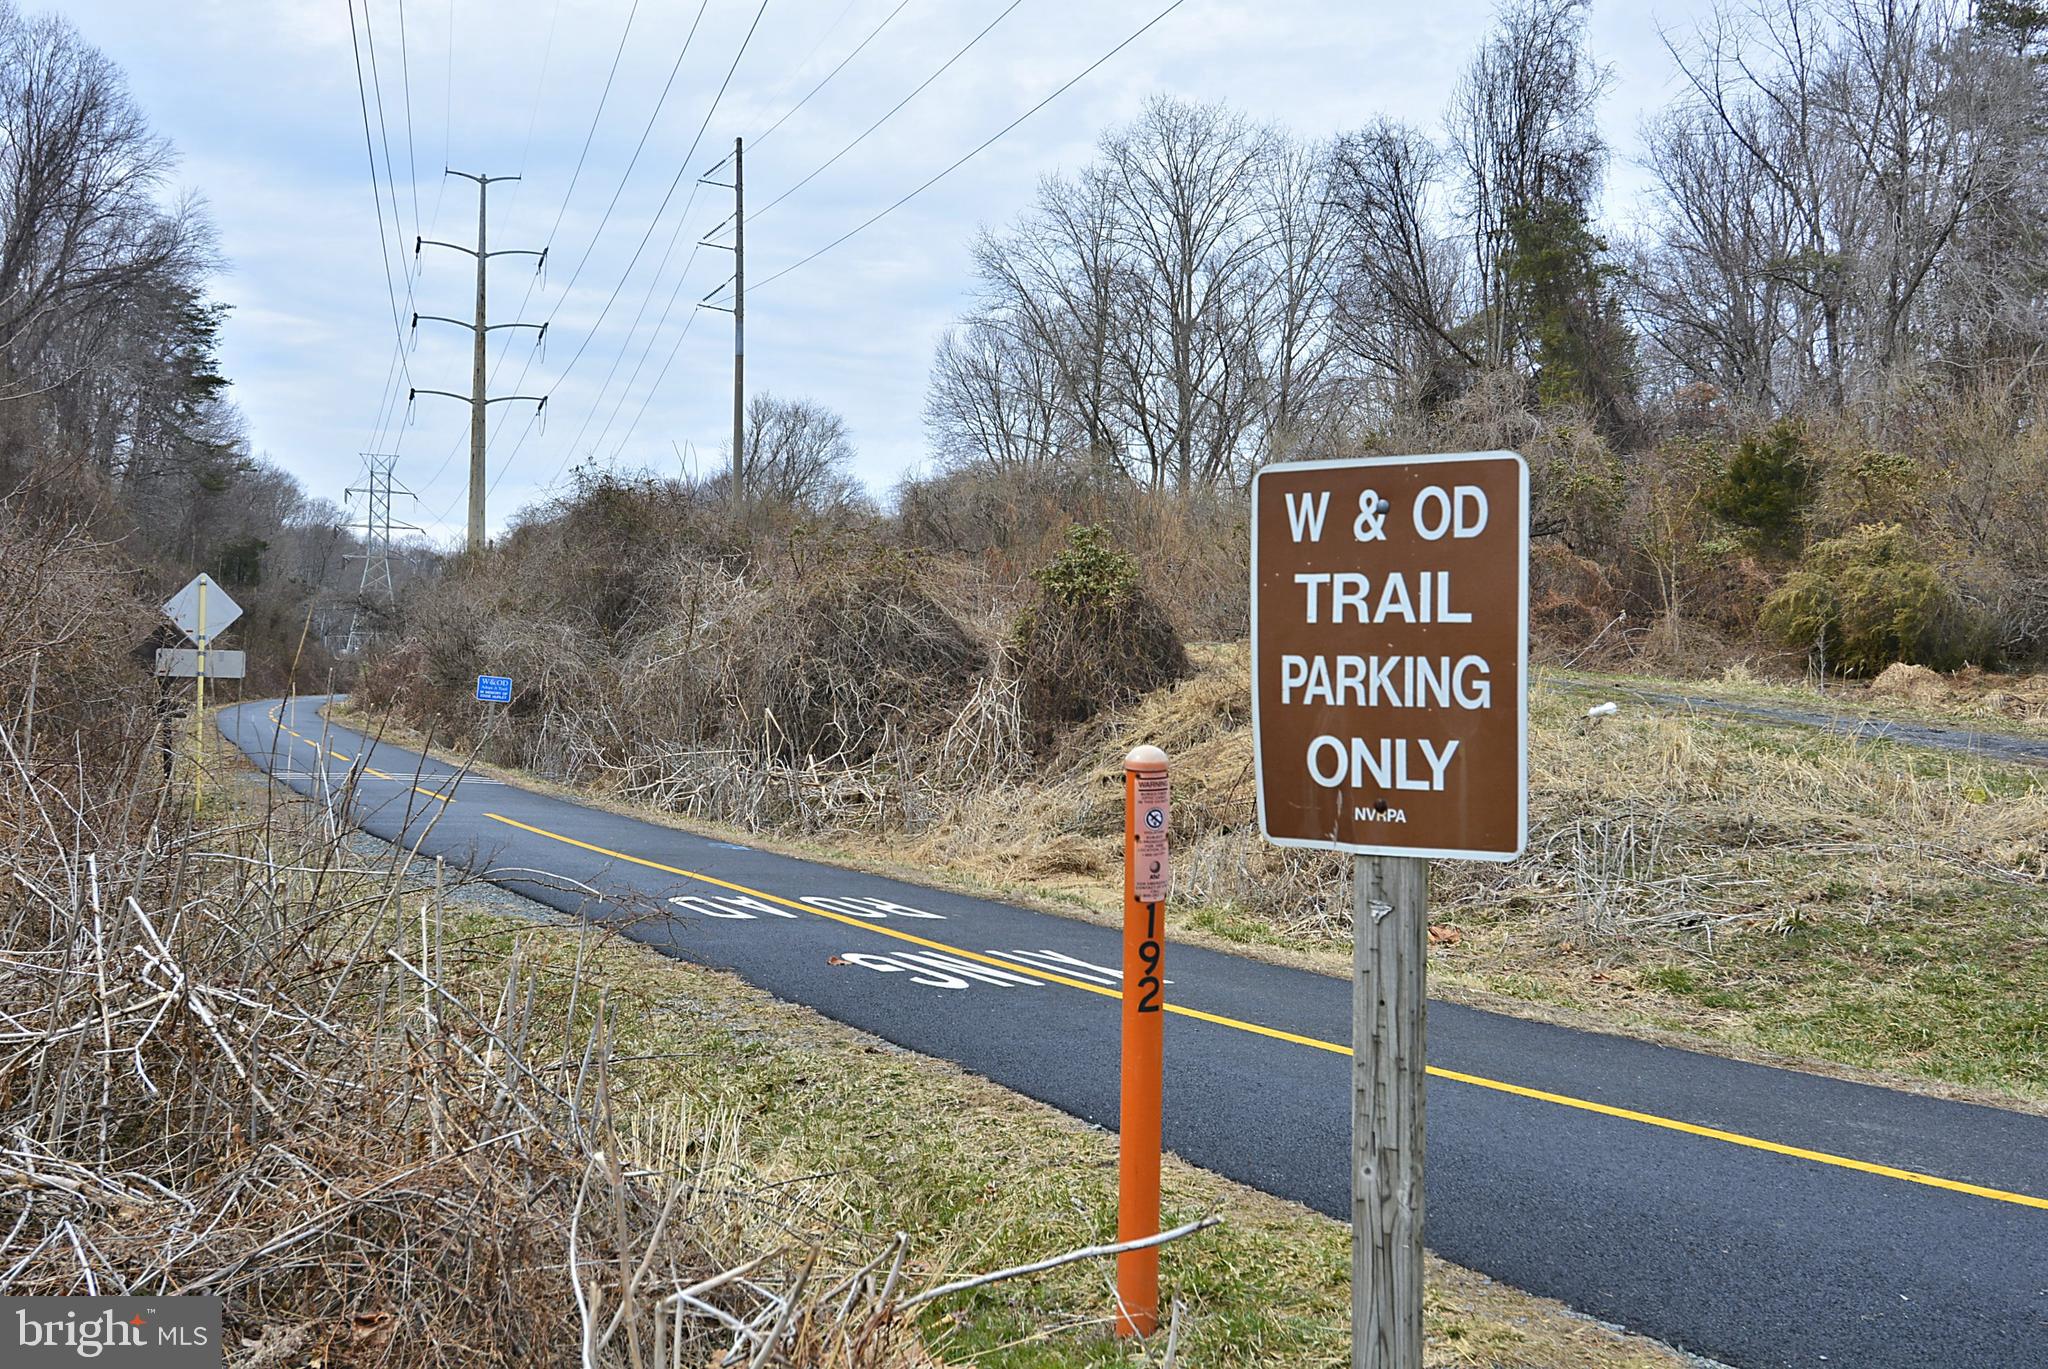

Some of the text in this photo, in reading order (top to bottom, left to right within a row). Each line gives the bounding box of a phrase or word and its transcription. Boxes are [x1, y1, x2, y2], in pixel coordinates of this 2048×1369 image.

[1285, 485, 1489, 543] W & OD
[1294, 570, 1473, 624] TRAIL
[1281, 653, 1492, 710] PARKING
[1307, 734, 1460, 791] ONLY
[1138, 902, 1161, 1012] 192
